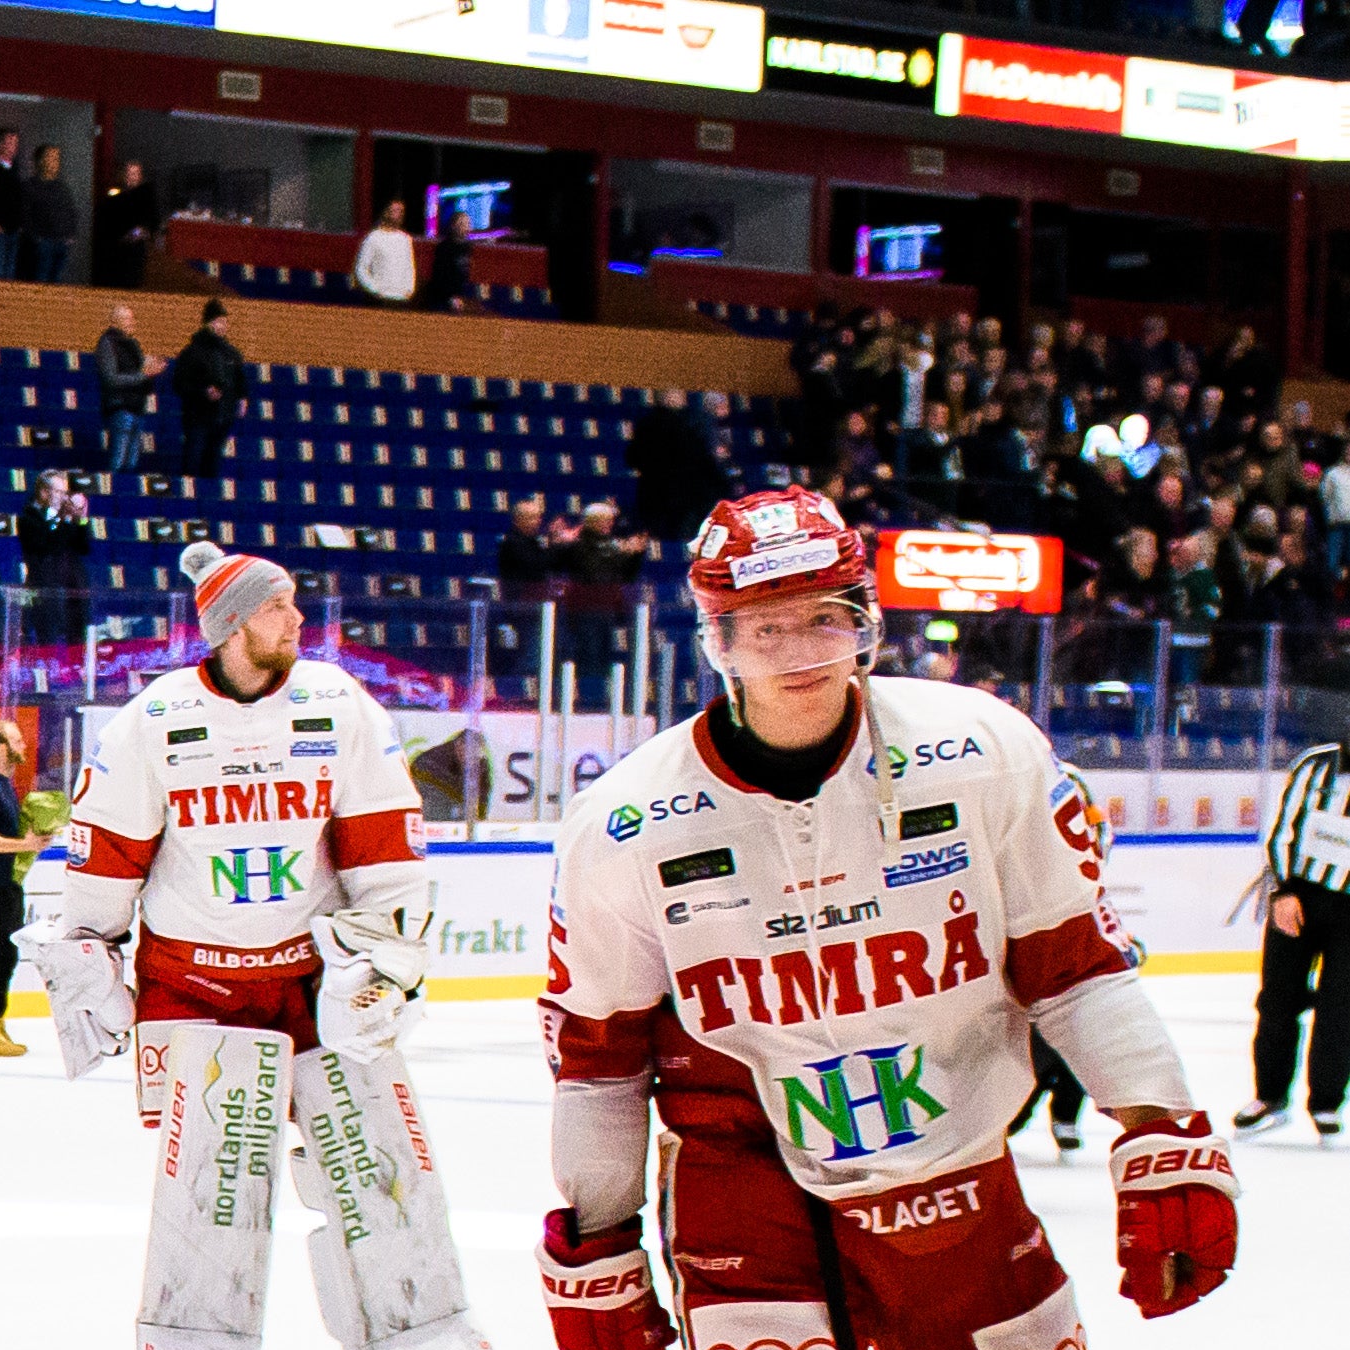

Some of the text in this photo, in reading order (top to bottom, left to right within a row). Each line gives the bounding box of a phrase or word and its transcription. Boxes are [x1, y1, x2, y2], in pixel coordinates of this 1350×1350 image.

[767, 38, 906, 83] KARLSTAD.SE
[171, 699, 205, 712] SCA
[315, 688, 349, 700] SCA
[914, 736, 984, 768] SCA
[168, 764, 334, 828] TIMRÅ
[649, 790, 717, 822] SCA
[193, 940, 313, 969] BILBOLAGE
[439, 919, 527, 956] frakt
[675, 888, 990, 1034] TIMRÅ
[164, 1080, 188, 1180] BAUER
[319, 1051, 380, 1189] norrlands
[392, 1082, 433, 1173] BAUER
[213, 1086, 247, 1227] norrlands
